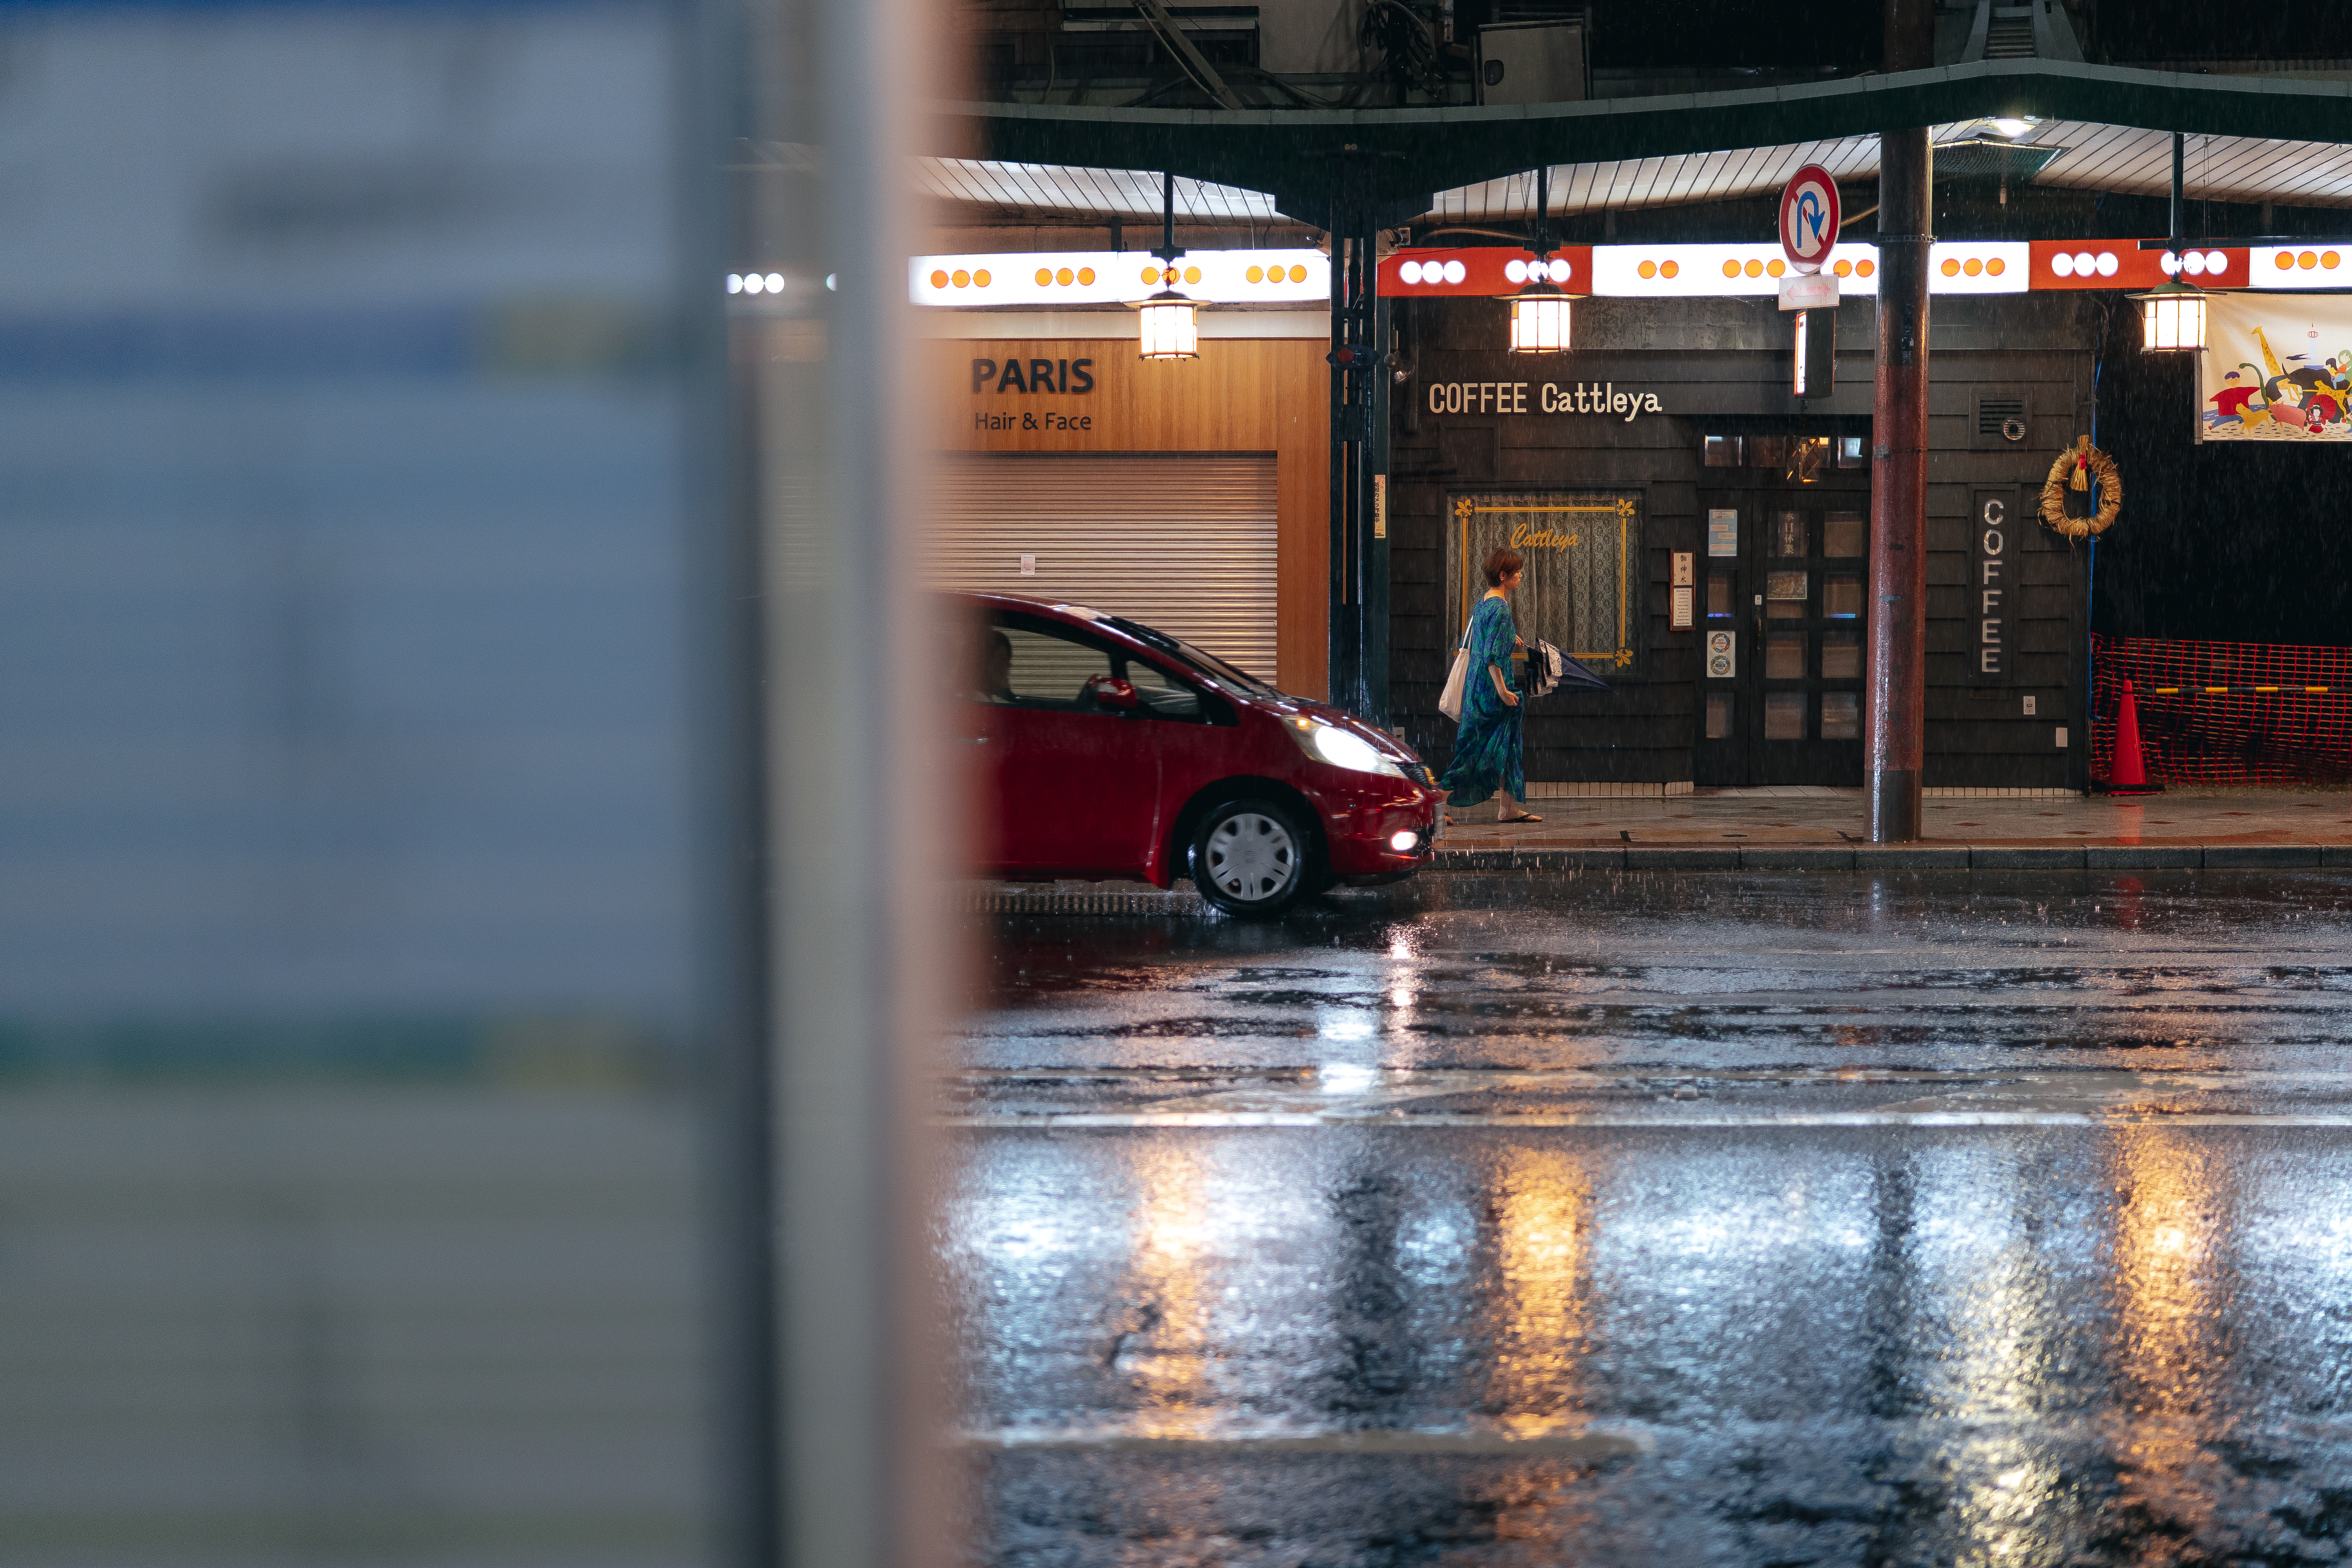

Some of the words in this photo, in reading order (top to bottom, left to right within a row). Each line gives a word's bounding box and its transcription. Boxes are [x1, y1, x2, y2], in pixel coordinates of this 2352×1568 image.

[973, 358, 1094, 394] PARIS
[1429, 383, 1528, 413] COFFEE
[1541, 382, 1663, 422] Cattleya
[975, 412, 1017, 430] Hair
[1022, 412, 1039, 431] &
[1045, 412, 1092, 431] Face
[1510, 523, 1578, 552] Cattleya
[1784, 512, 1794, 554] 本日休業
[1981, 499, 2004, 672] COFFEE
